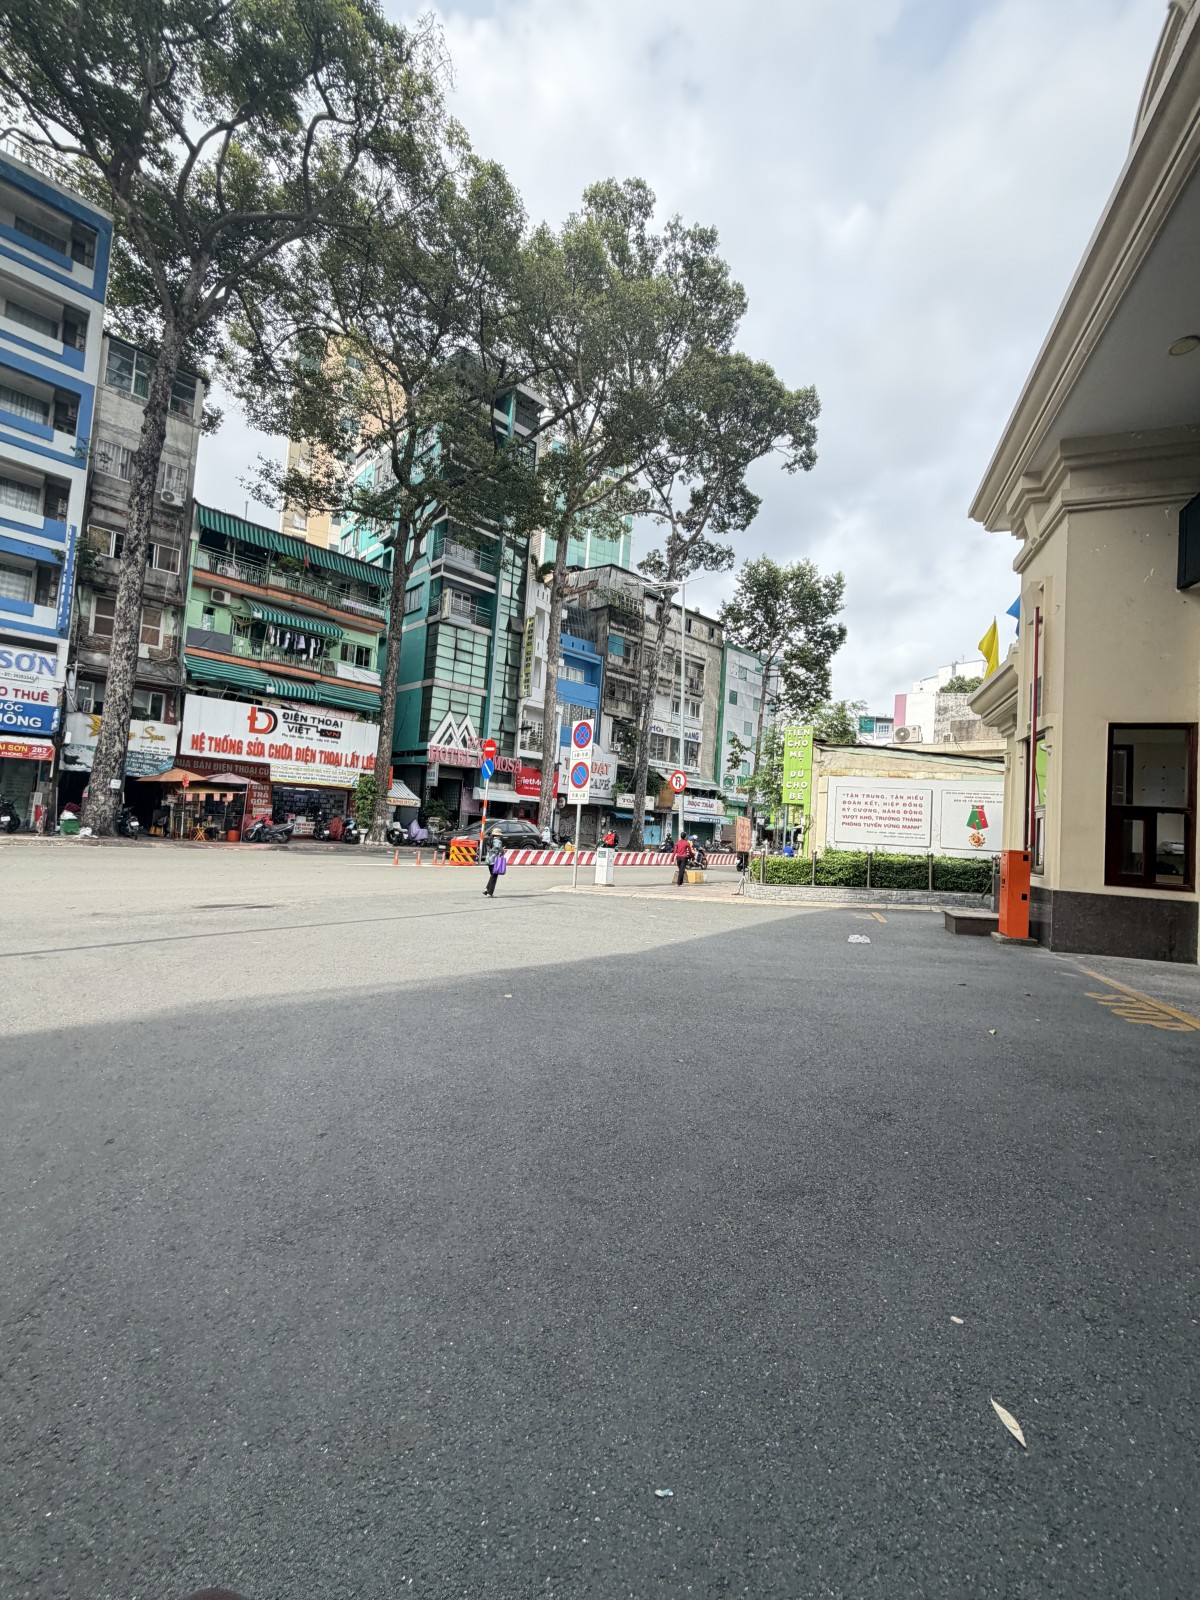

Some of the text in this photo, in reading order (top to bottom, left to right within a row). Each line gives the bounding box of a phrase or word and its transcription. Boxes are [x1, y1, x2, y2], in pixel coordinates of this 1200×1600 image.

[12, 688, 49, 703] THUÊ
[282, 711, 343, 728] ĐIỆN THOẠI
[287, 724, 311, 735] VIỆT
[8, 744, 28, 753] SƠN
[191, 732, 206, 753] HỆ
[208, 733, 243, 755] THỐNG
[246, 736, 265, 758] SỬA
[268, 740, 293, 761] CHỮA
[295, 746, 317, 765] ĐIỆN
[318, 750, 343, 768] THOẠI
[345, 750, 360, 769] LẤY
[429, 745, 522, 773] HOTEL MMOSA
[213, 762, 232, 773] ĐIỆN
[235, 764, 257, 774] THOẠI
[786, 781, 808, 789] CHO
[1084, 992, 1196, 1032] STOP
